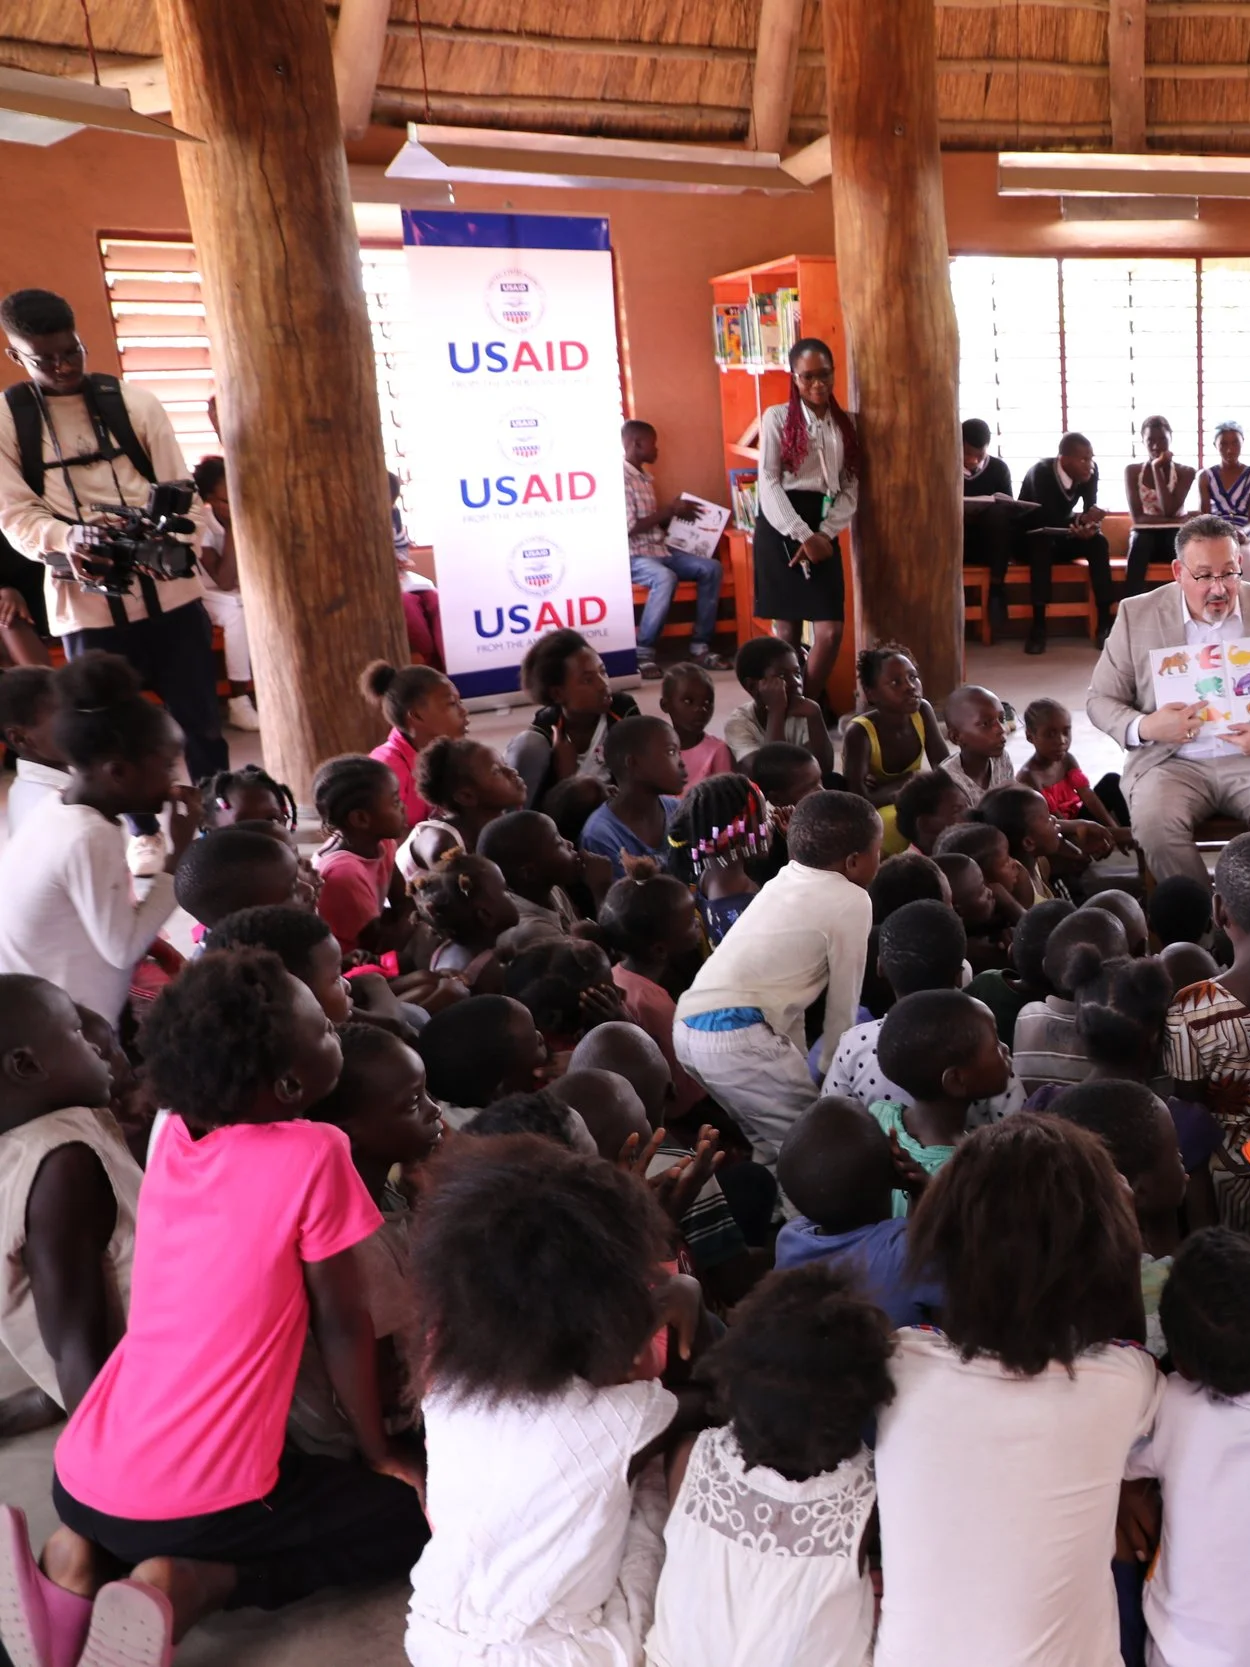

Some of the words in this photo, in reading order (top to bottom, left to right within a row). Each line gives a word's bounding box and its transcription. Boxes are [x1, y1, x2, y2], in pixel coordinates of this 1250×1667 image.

[448, 341, 589, 374] USAID
[460, 471, 597, 509] USAID
[474, 595, 608, 639] USAID
[476, 642, 504, 654] FROM
[506, 640, 525, 650] THE
[581, 628, 609, 638] EOPLE
